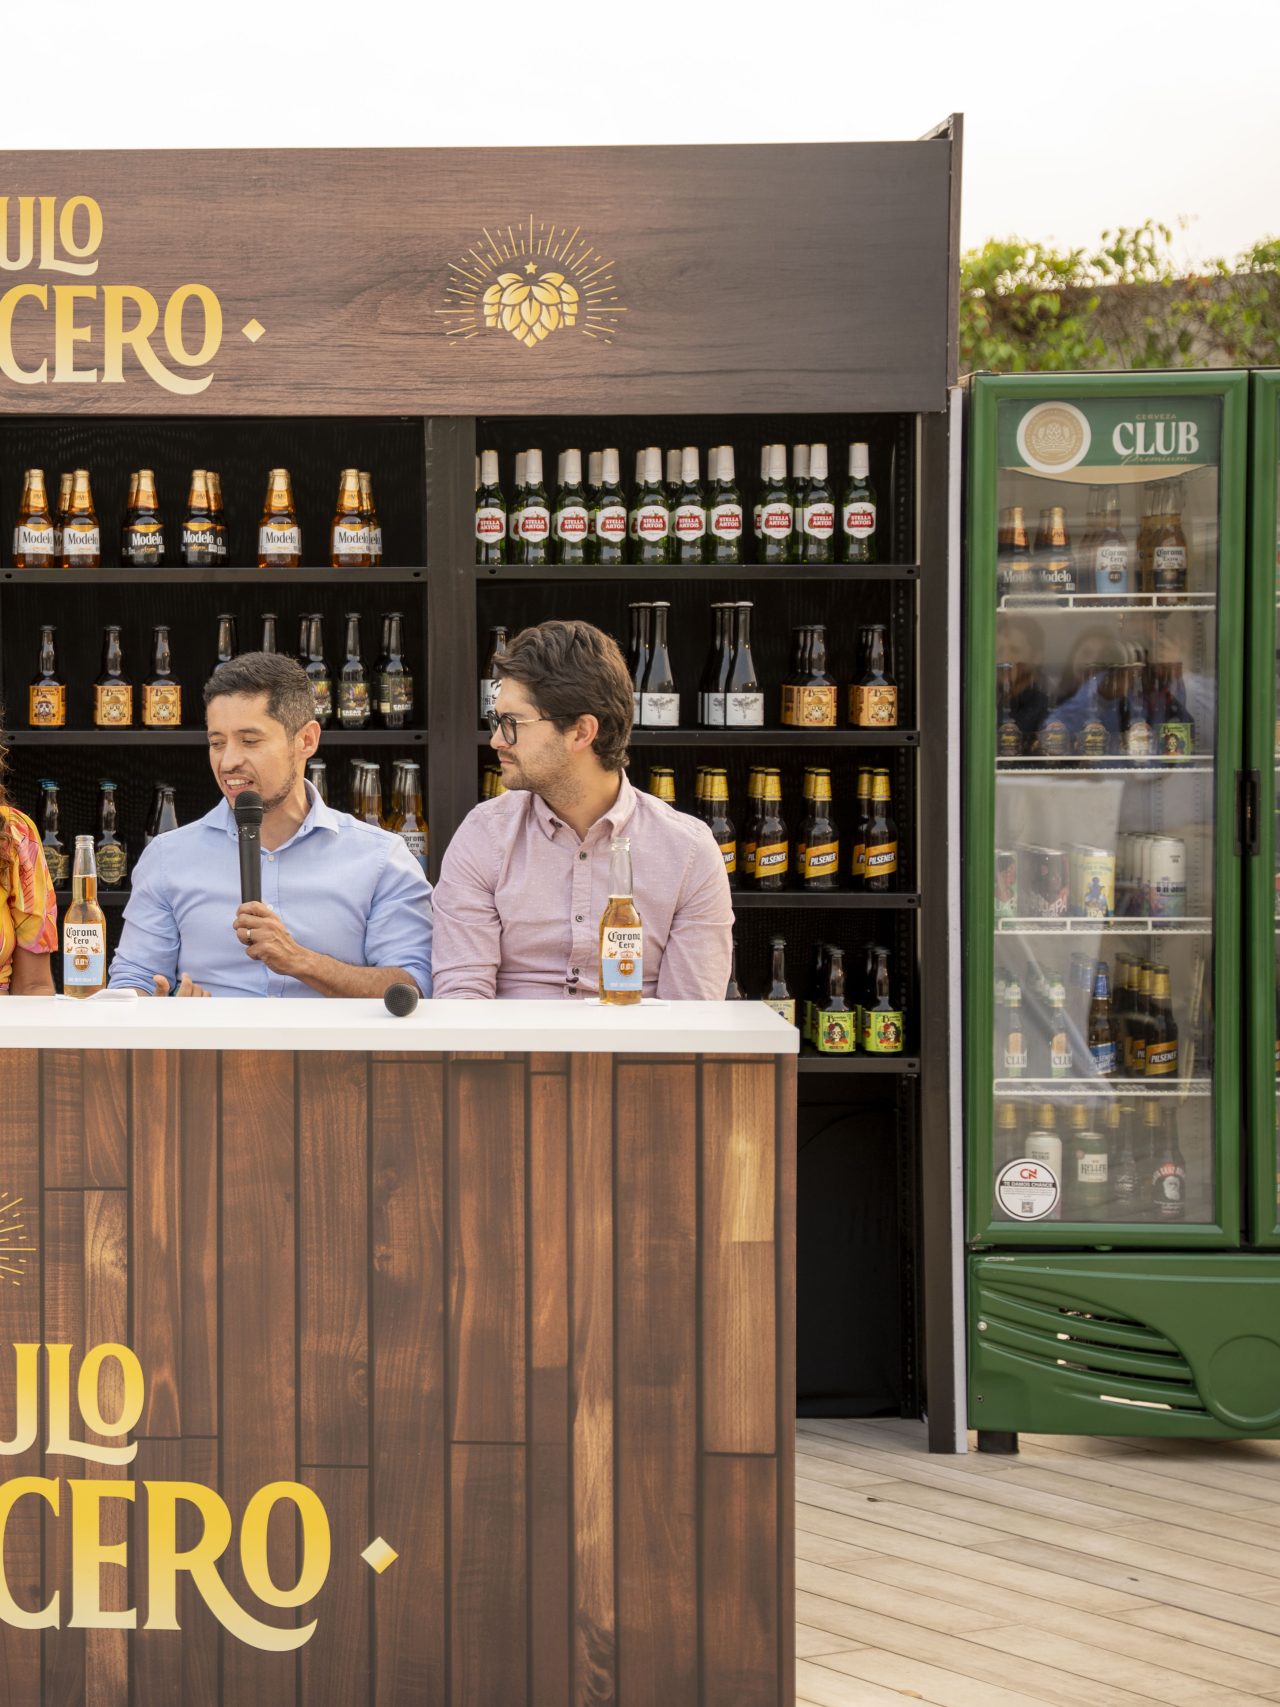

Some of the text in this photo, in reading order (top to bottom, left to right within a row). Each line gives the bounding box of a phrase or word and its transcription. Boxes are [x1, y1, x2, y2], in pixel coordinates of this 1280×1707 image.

[1112, 421, 1199, 455] CLUB
[23, 532, 53, 544] Modelo
[132, 532, 163, 546] Modelo
[183, 530, 214, 544] Modelo
[760, 853, 786, 865] PILSENER
[810, 853, 836, 866] PILSENER
[869, 853, 895, 865] PILSENER
[66, 927, 99, 938] Corona
[608, 931, 641, 943] Corona
[73, 936, 89, 945] Cero
